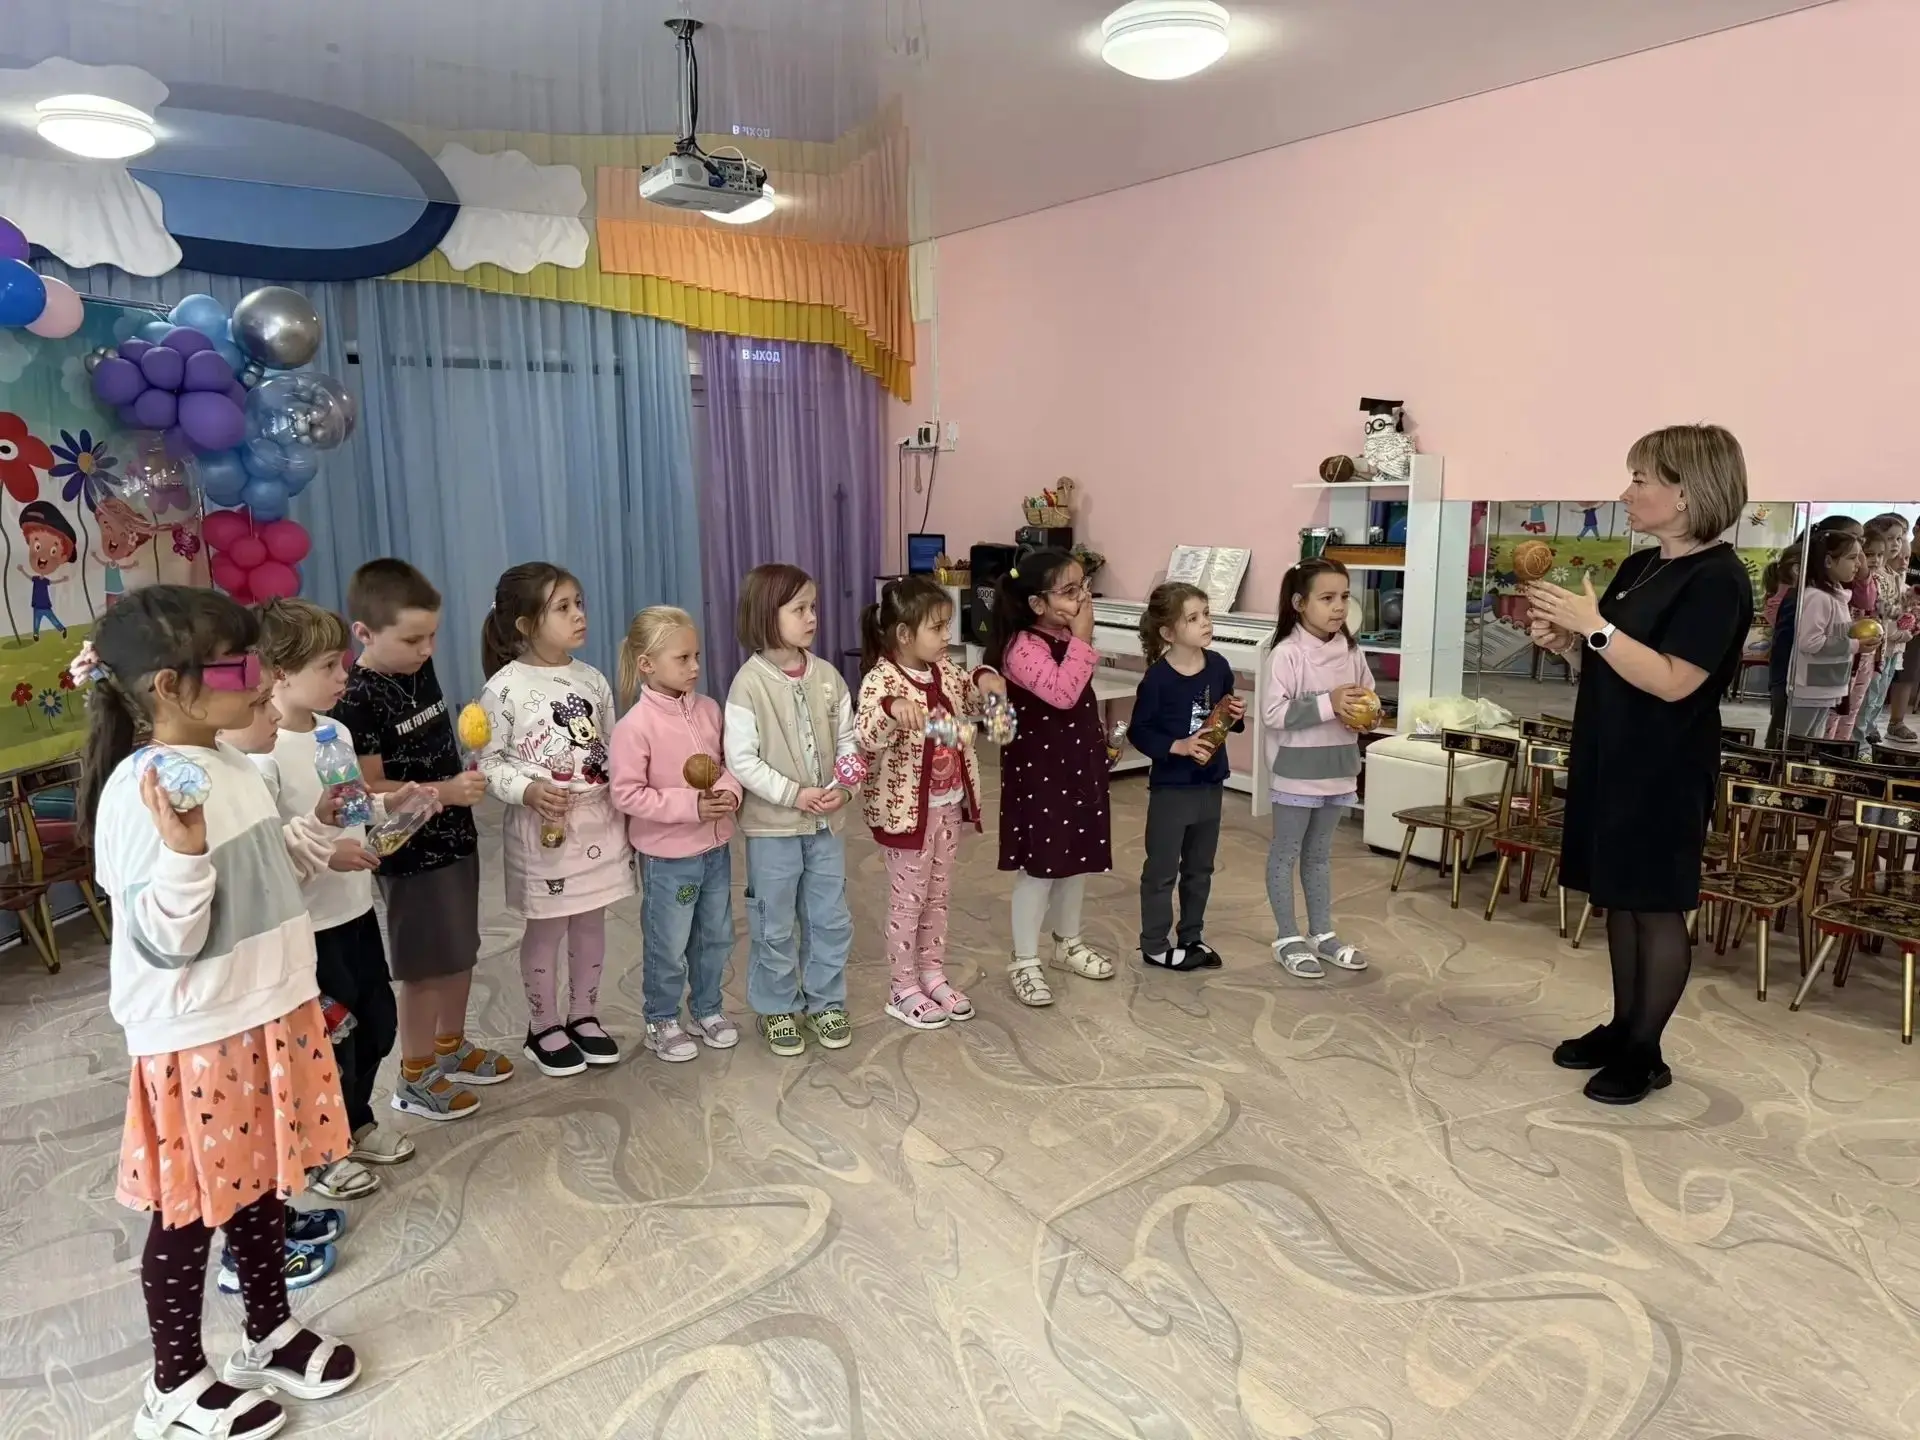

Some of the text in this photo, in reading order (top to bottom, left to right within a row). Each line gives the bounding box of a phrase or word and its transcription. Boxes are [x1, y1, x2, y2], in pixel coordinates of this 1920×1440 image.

[395, 718, 414, 736] THE
[412, 703, 440, 728] FUTURE
[773, 1027, 795, 1039] NICE
